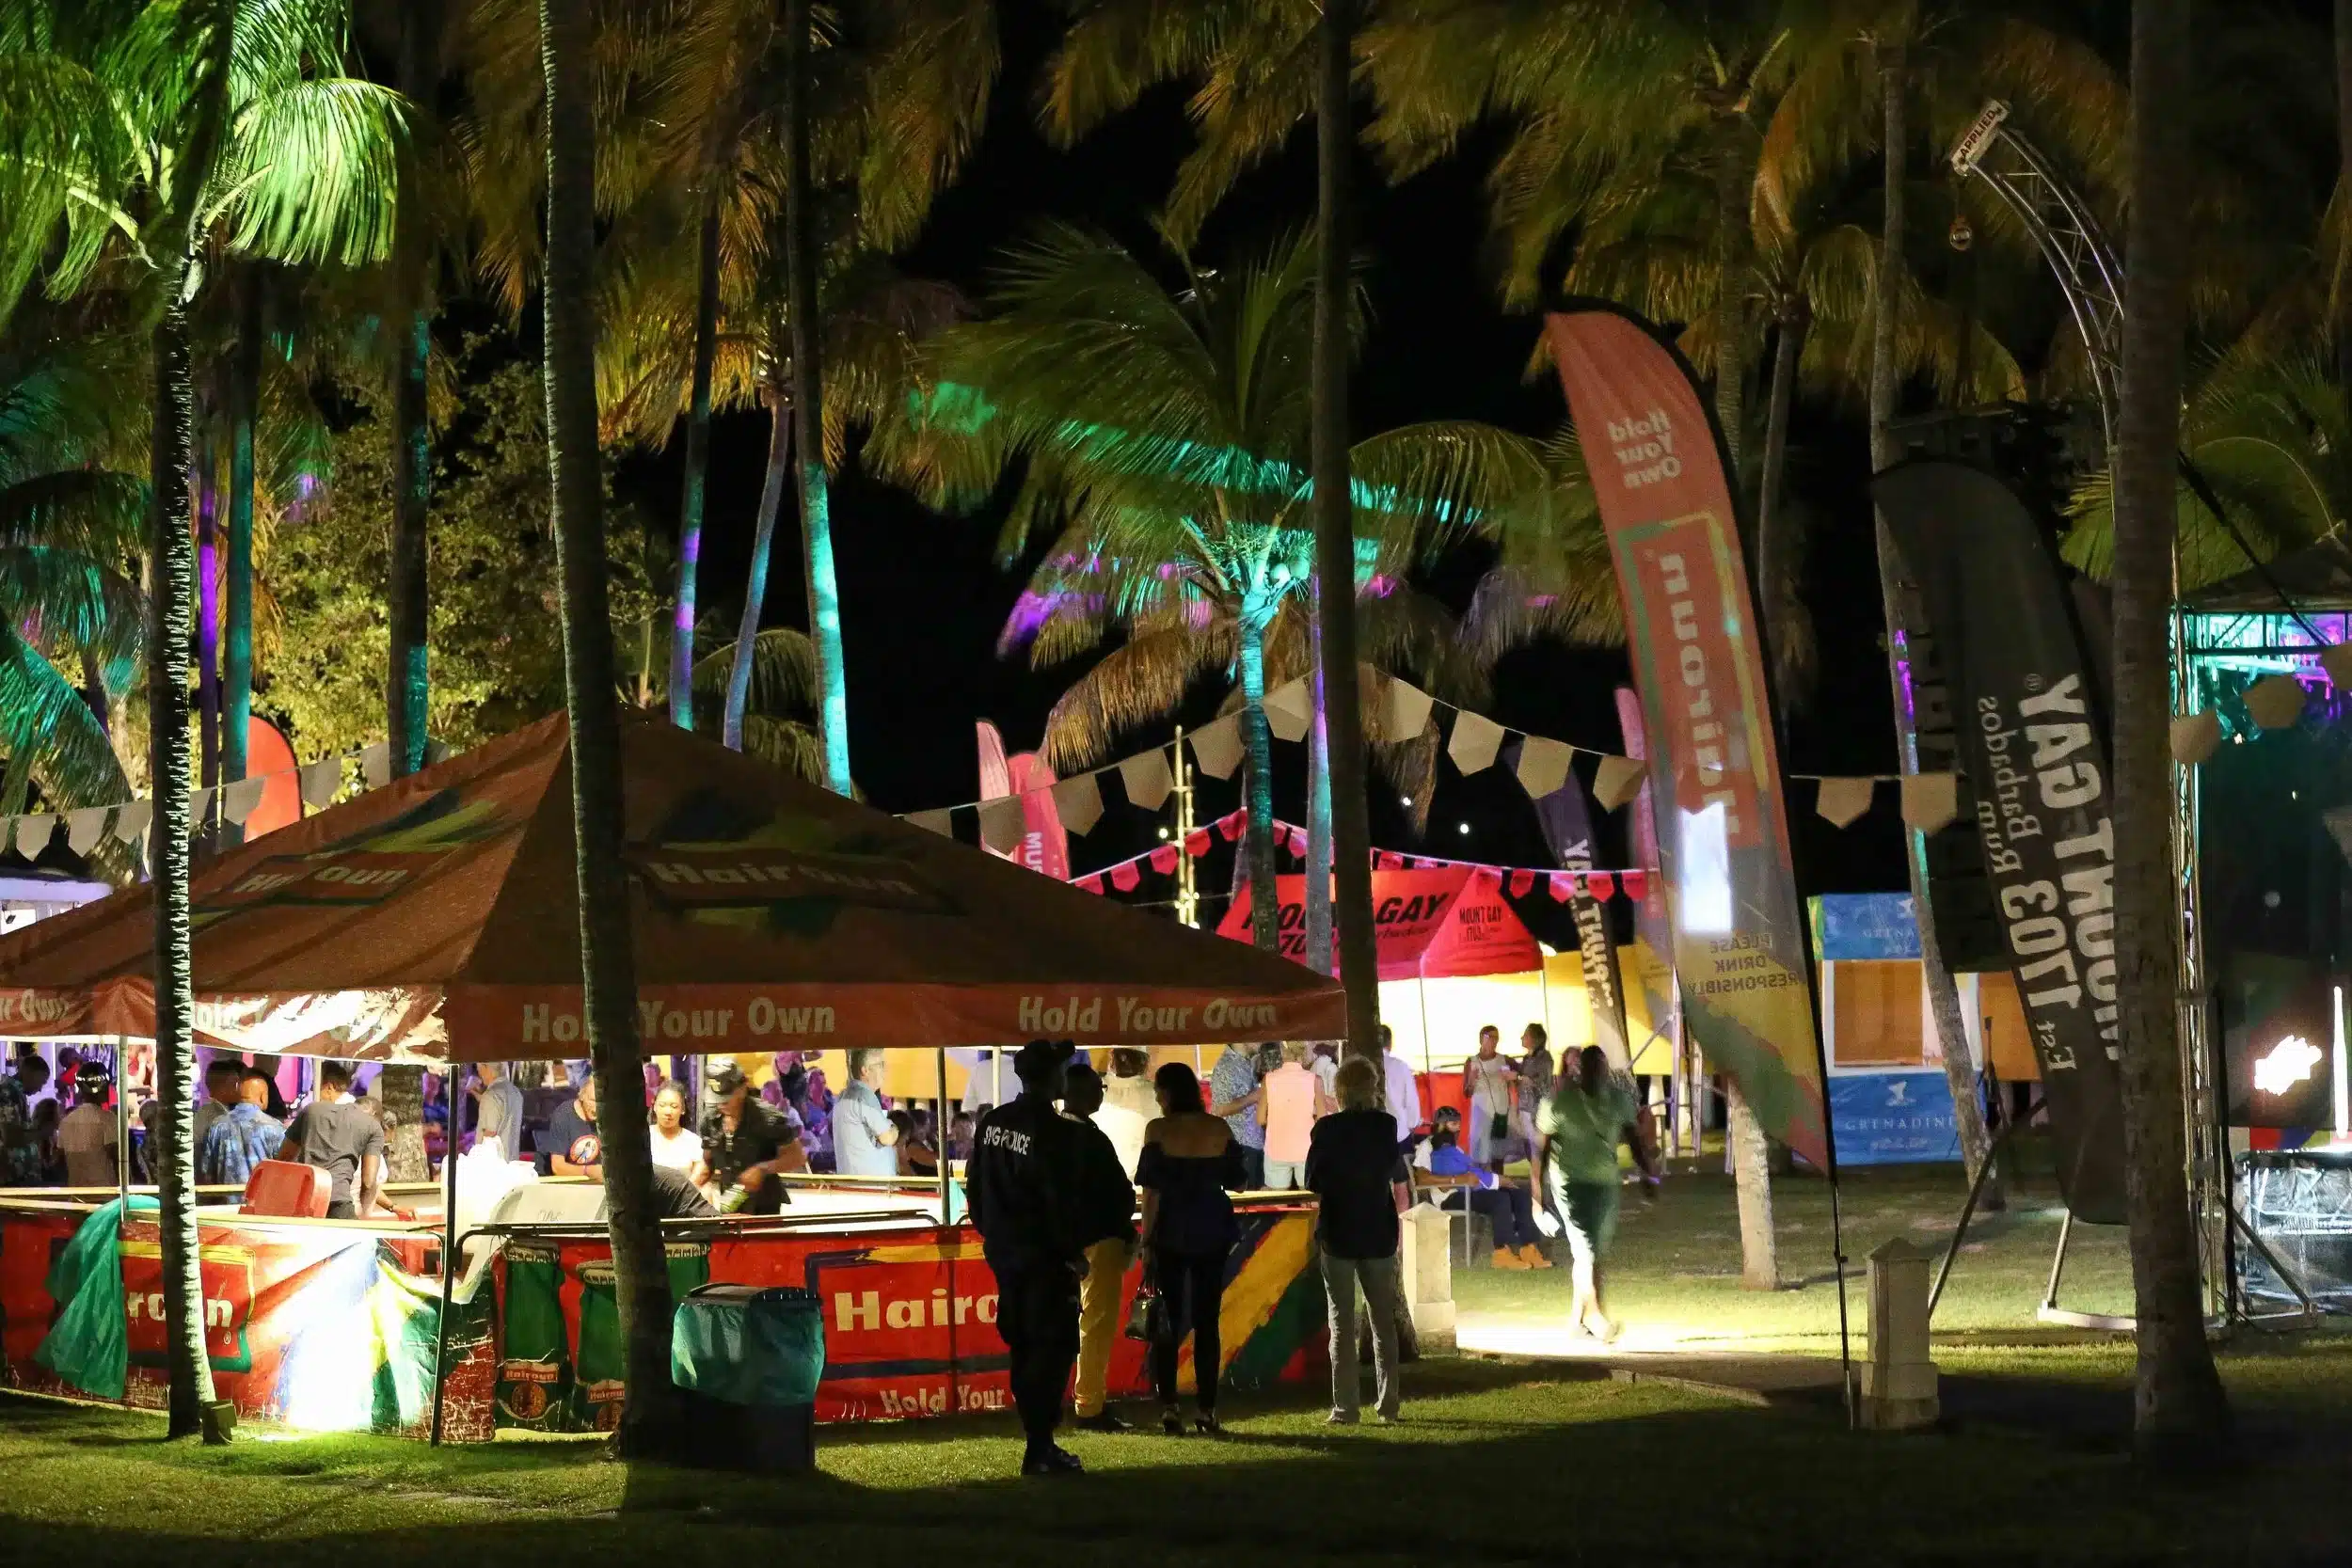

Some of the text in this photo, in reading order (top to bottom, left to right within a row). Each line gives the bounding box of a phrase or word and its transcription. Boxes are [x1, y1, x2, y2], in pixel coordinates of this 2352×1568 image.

[1960, 109, 1995, 160] APPLIED
[1376, 893, 1450, 925] GAY
[639, 1000, 733, 1037] Your
[749, 996, 834, 1035] Own
[1019, 996, 1276, 1032] Hold Your Own
[880, 1385, 1005, 1415] Hold Your
